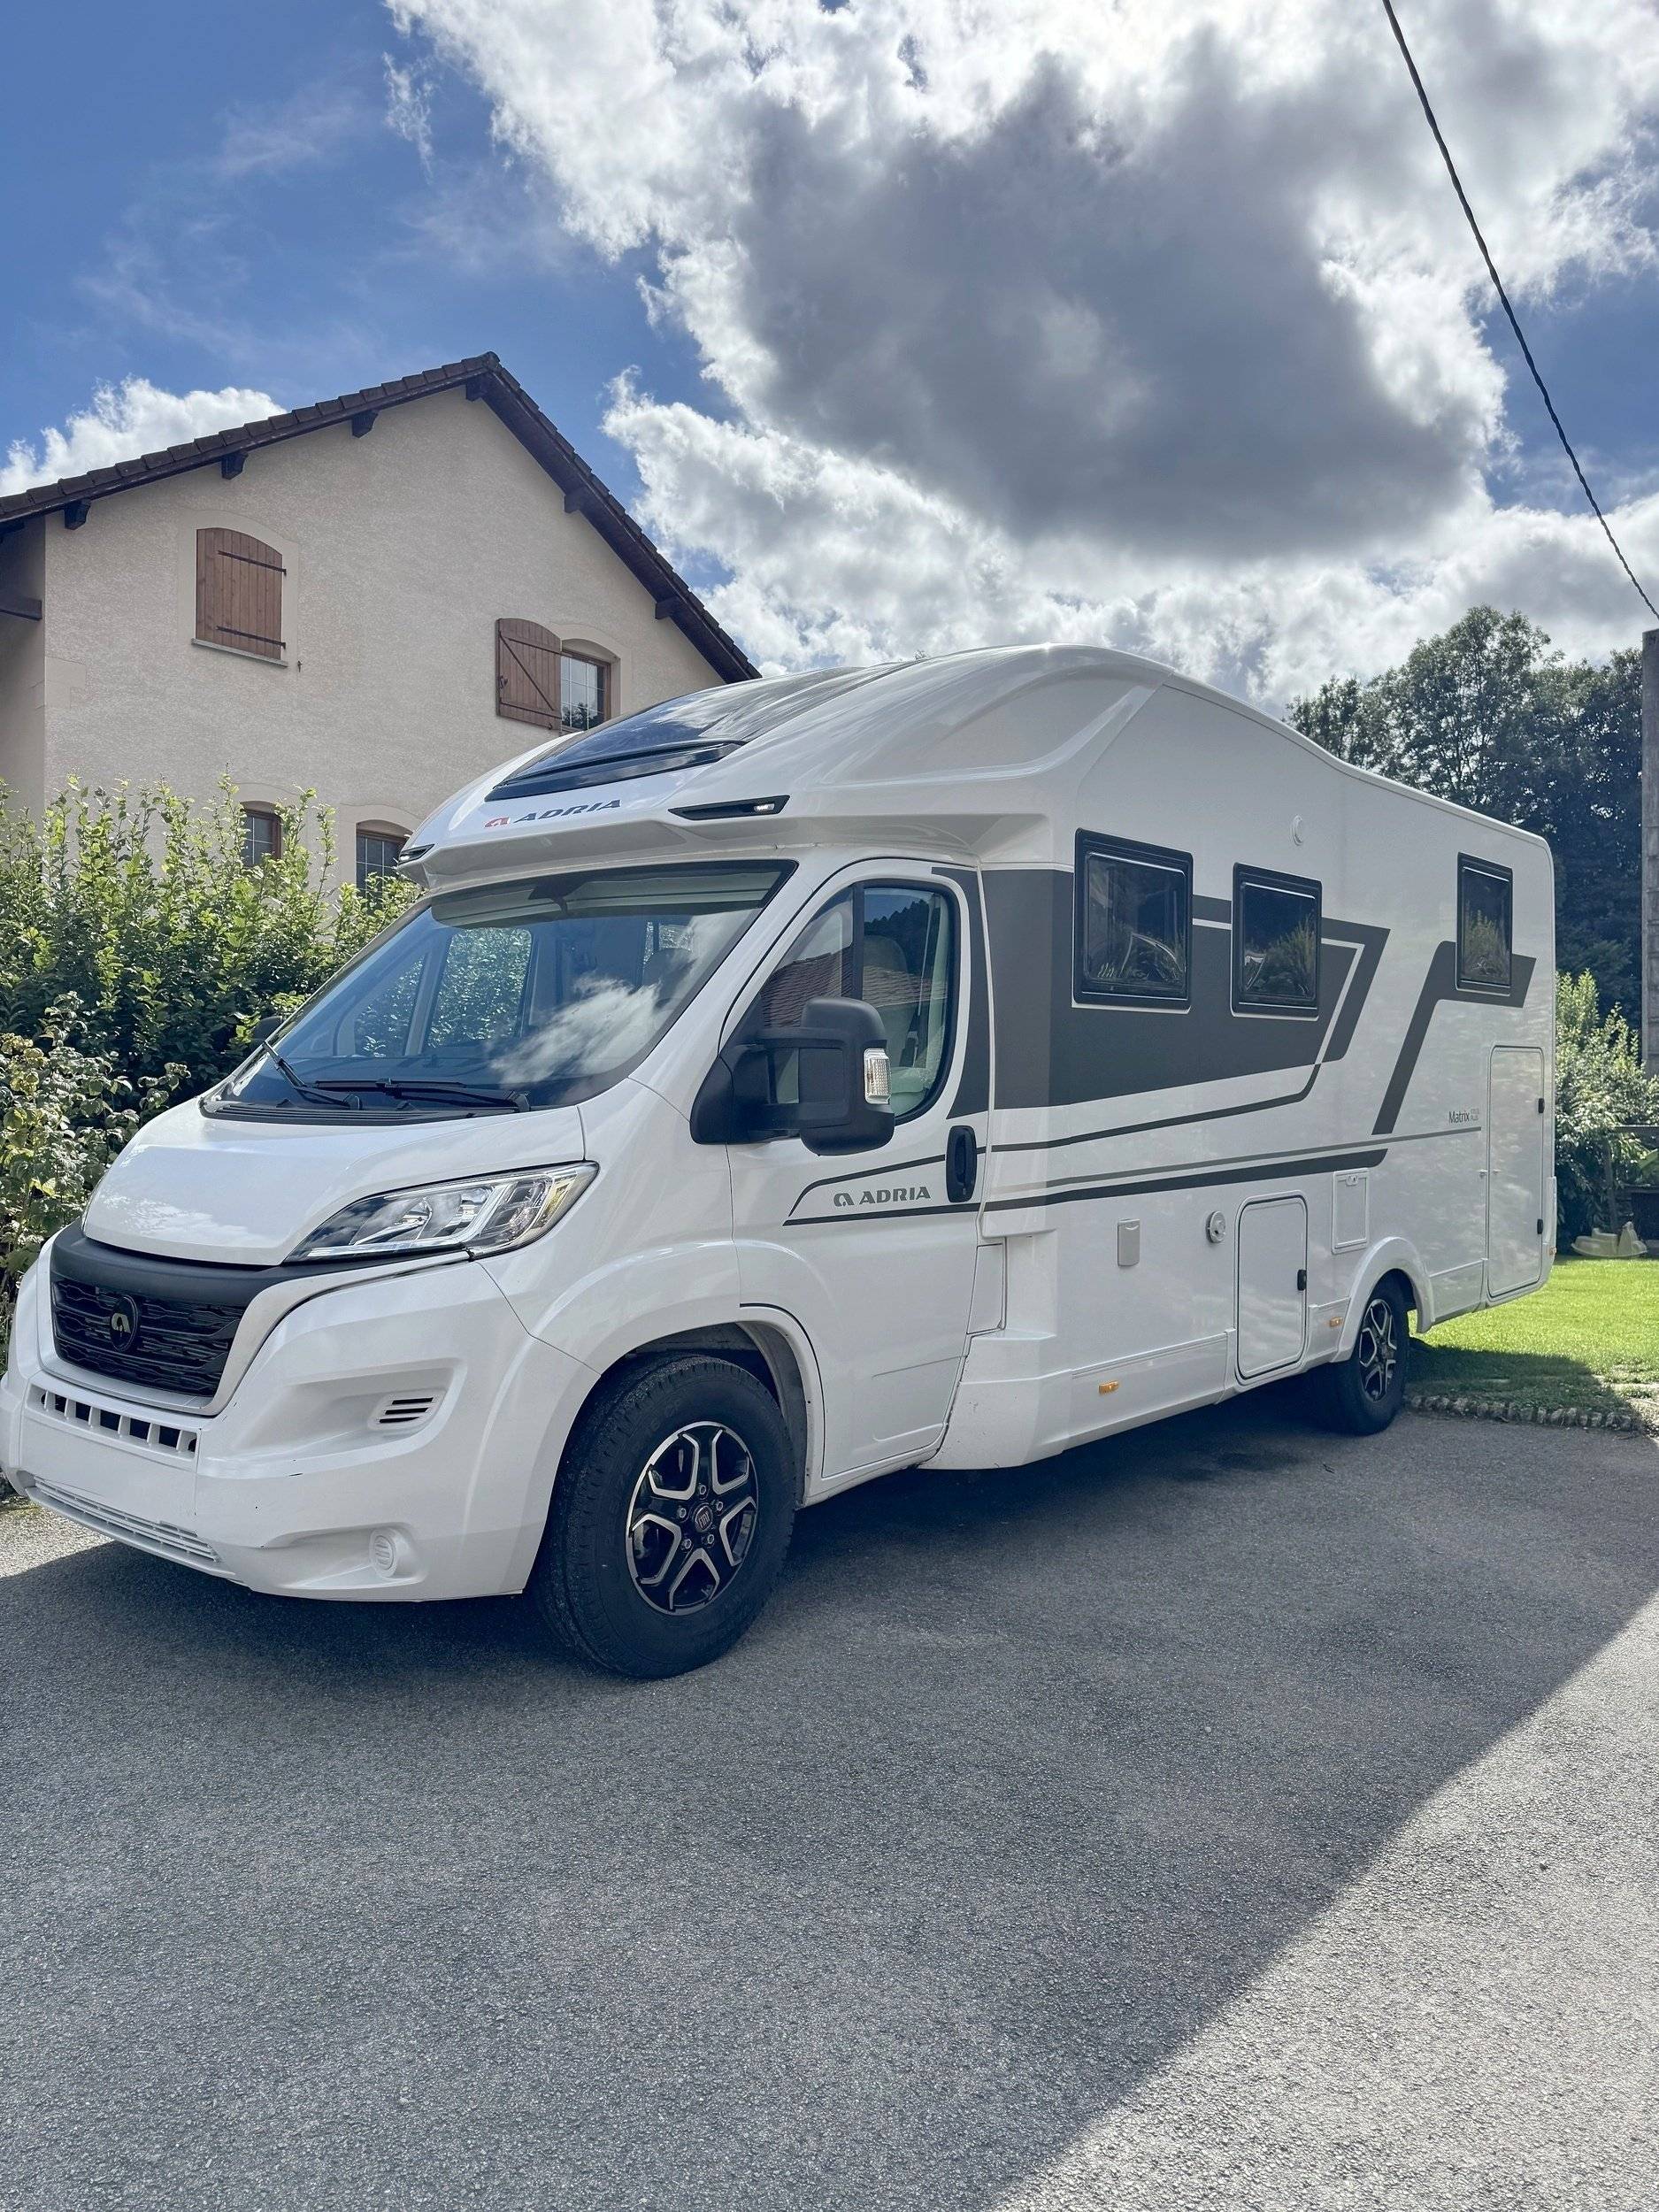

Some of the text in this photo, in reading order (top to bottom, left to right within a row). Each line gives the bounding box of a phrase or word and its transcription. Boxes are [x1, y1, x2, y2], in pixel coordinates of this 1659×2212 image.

[513, 799, 621, 823] ADRIA
[1448, 1110, 1470, 1124] Matrix
[859, 1186, 931, 1205] ADRIA
